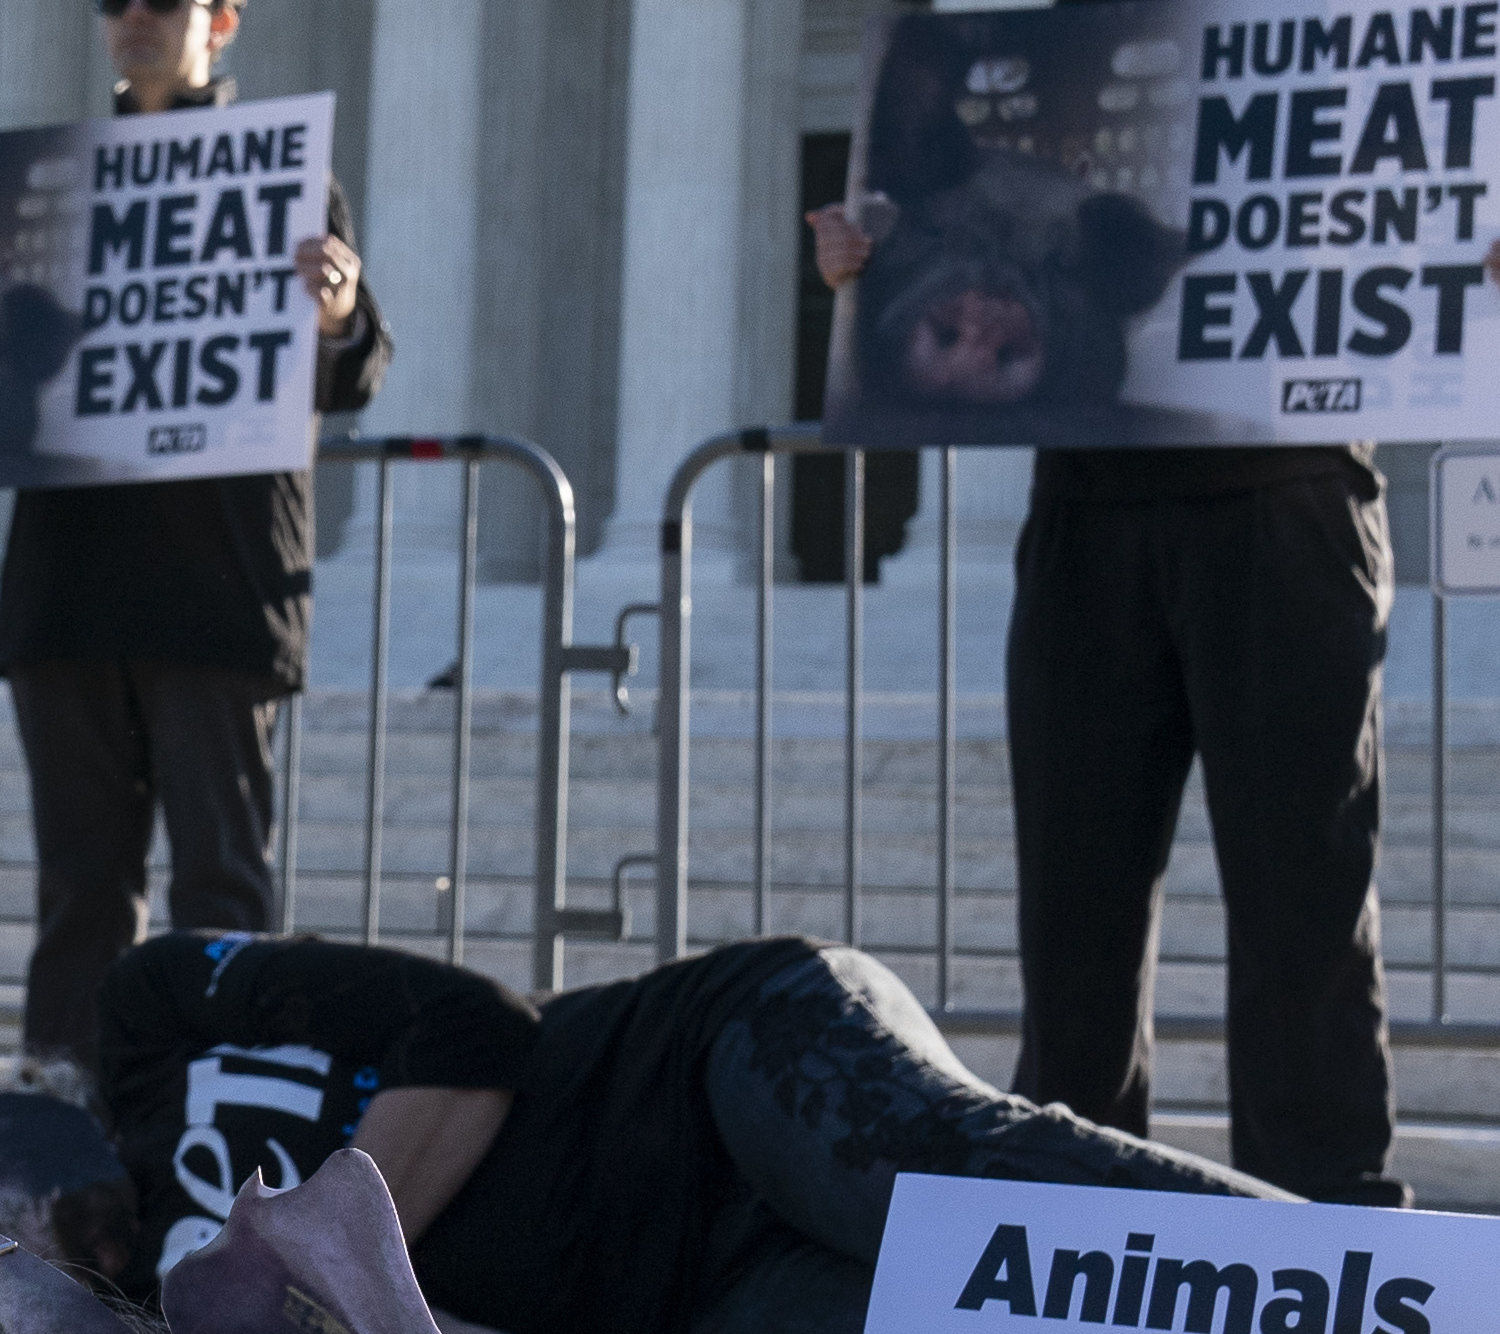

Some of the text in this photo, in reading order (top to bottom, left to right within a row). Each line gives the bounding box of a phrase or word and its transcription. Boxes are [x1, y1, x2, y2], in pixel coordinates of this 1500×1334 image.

[1201, 1, 1499, 81] HUMANE
[94, 124, 307, 191] HUMANE
[1192, 75, 1496, 186] MEAT
[90, 182, 303, 275] MEAT
[1186, 183, 1488, 252] DOESN'T
[84, 268, 297, 329] DOESN'T
[1176, 263, 1485, 361] EXIST
[74, 330, 291, 416] EXIST
